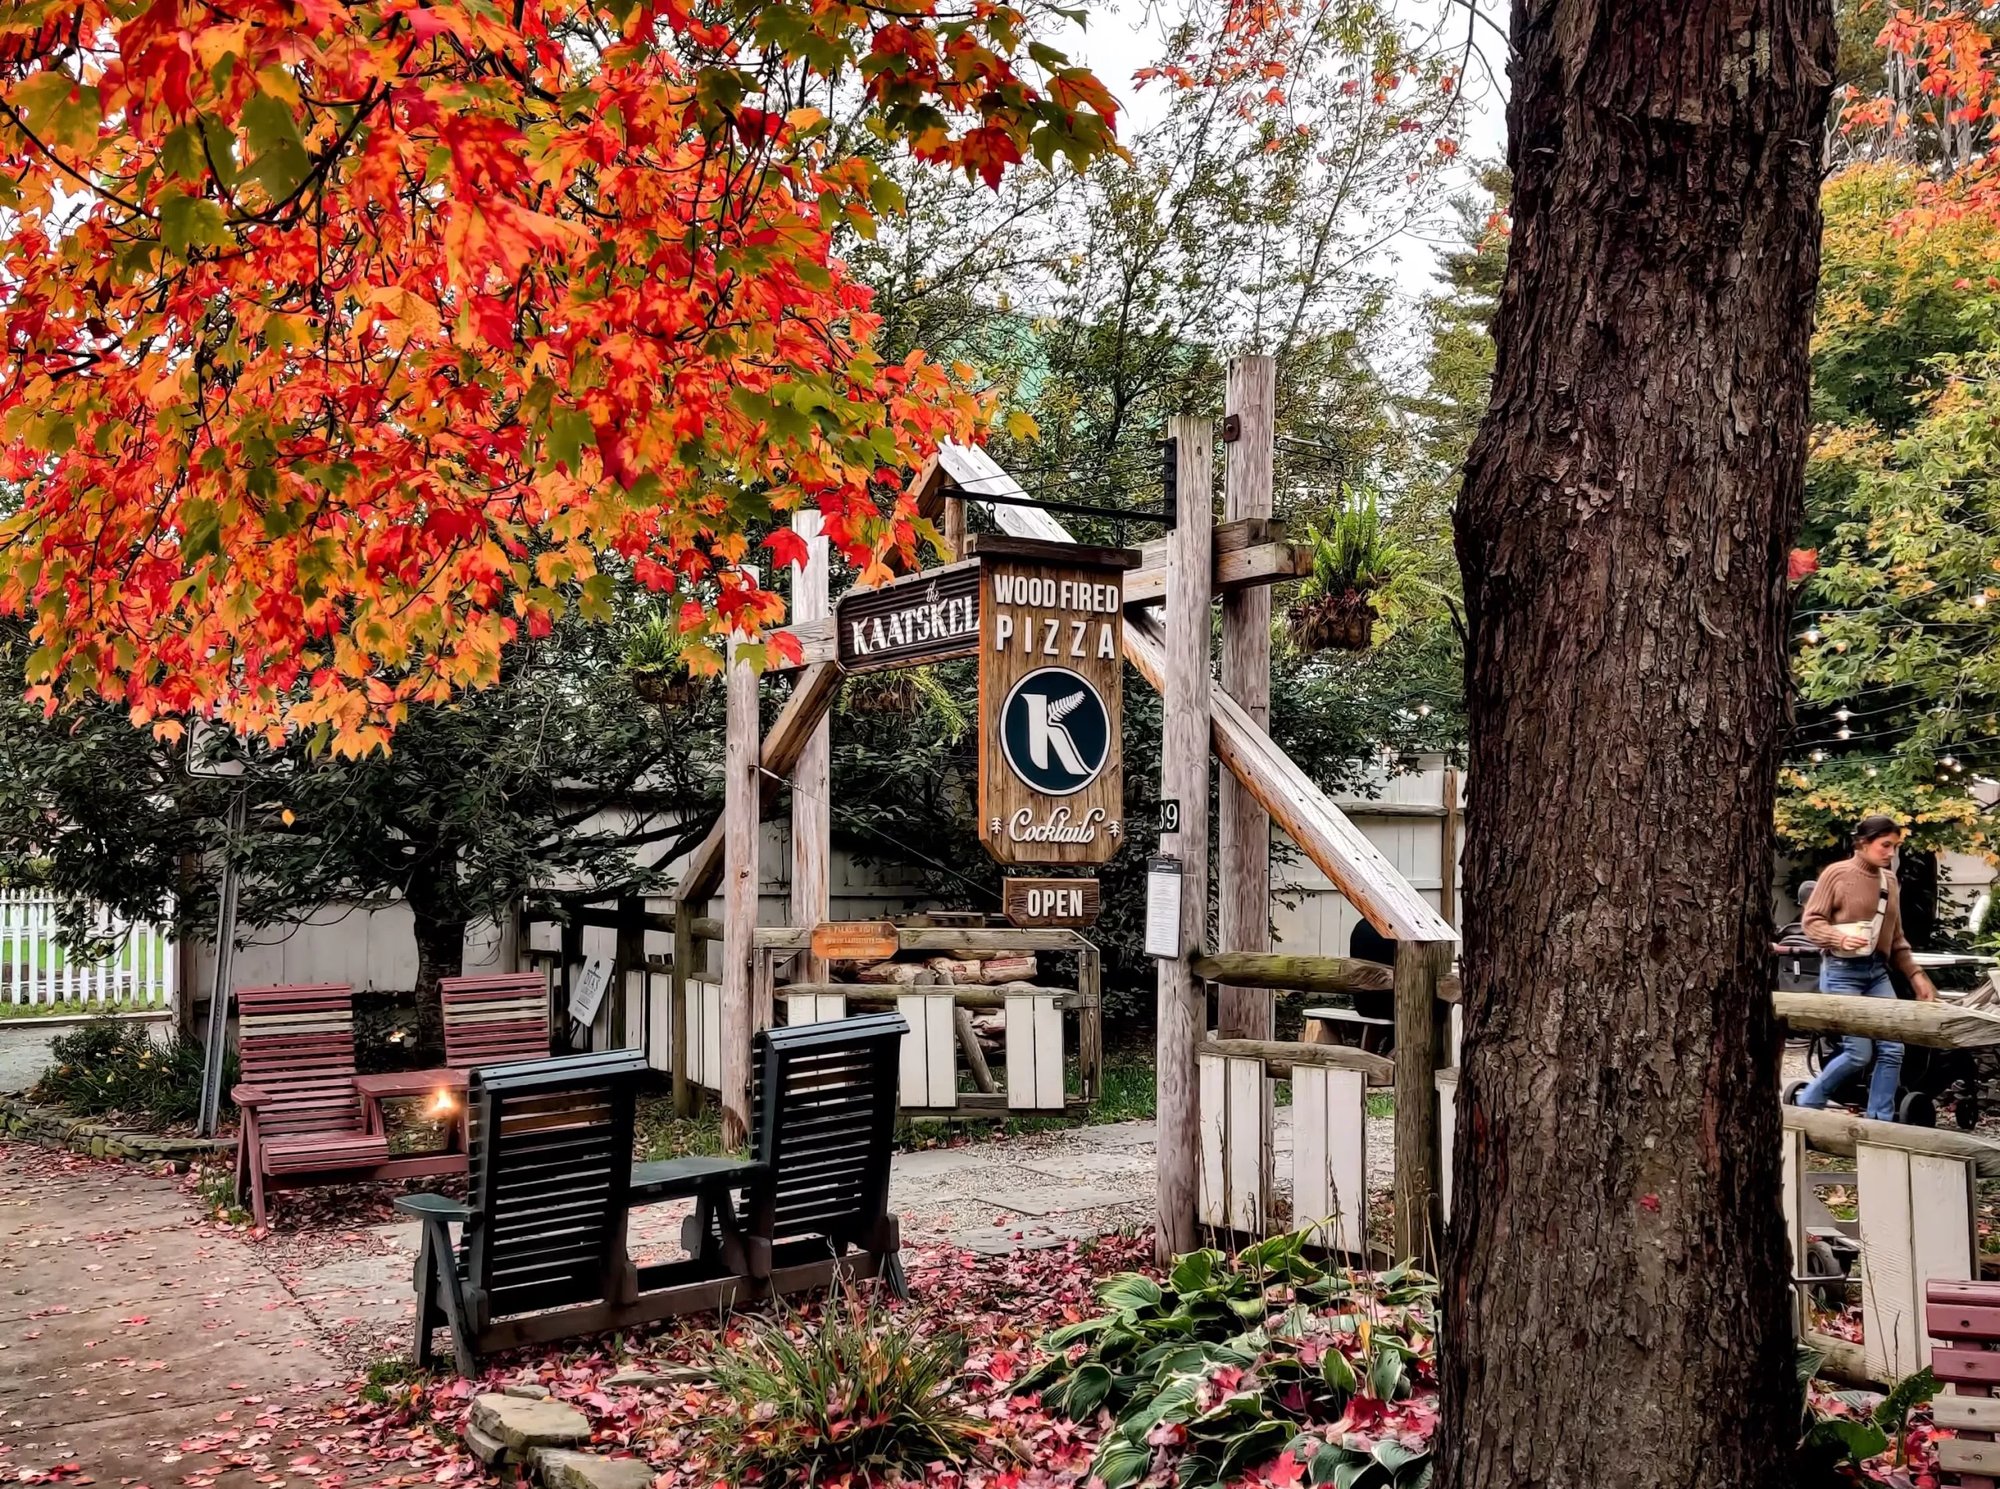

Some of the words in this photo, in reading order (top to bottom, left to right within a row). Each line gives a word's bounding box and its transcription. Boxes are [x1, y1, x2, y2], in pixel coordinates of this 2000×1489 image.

[925, 579, 940, 603] the
[994, 574, 1057, 608] WOOD
[1060, 580, 1119, 613] FIRED
[996, 614, 1116, 659] PIZZA
[1020, 690, 1096, 775] K
[1009, 806, 1106, 843] Cocktails
[1027, 889, 1083, 917] OPEN
